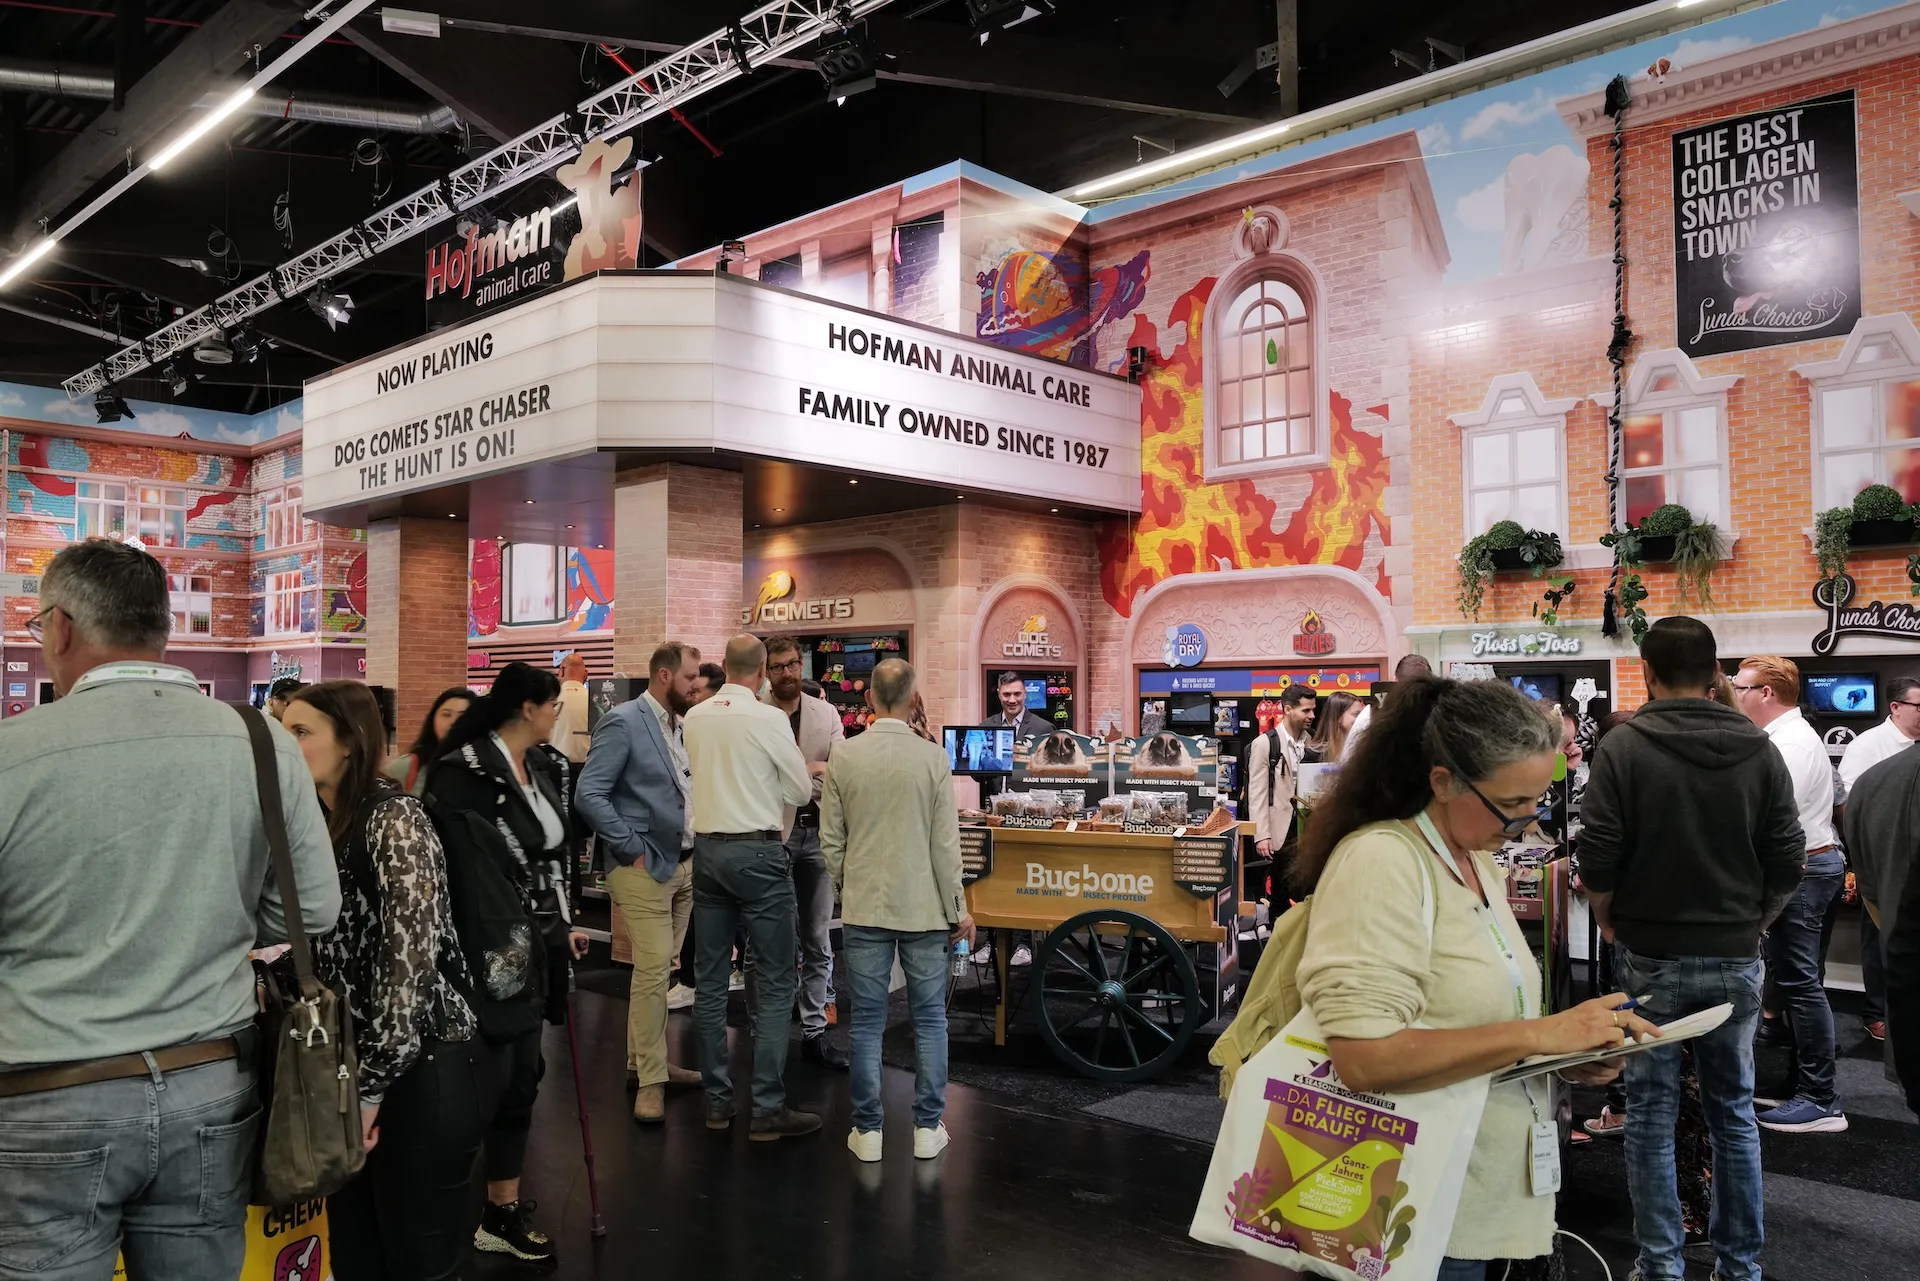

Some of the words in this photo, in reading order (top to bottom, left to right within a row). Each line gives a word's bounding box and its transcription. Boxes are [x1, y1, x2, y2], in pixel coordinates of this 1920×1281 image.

[1680, 128, 1728, 166] THE
[1736, 109, 1803, 153] BEST
[1681, 140, 1815, 198] COLLAGEN
[1682, 181, 1784, 230] SNACKS
[1793, 172, 1820, 207] IN
[426, 206, 552, 300] Hofman
[1682, 219, 1757, 262] TOWN
[476, 272, 519, 306] animal
[521, 262, 551, 288] care
[1753, 303, 1813, 327] Choice
[378, 359, 417, 394] NOW
[422, 333, 494, 380] PLAYING
[829, 322, 941, 374] HOFMAN
[950, 353, 1036, 396] ANIMAL
[1042, 376, 1090, 408] CARE
[335, 438, 365, 467] DOG
[370, 419, 428, 458] COMETS
[434, 407, 474, 440] STAR
[479, 384, 551, 427] CHASER
[799, 387, 890, 428] FAMILY
[898, 407, 989, 446] OWNED
[997, 427, 1054, 459] SINCE
[1063, 440, 1109, 469] 1987
[360, 464, 387, 490] THE
[395, 449, 443, 482] HUNT
[451, 442, 468, 468] IS
[476, 429, 516, 462] ON!
[761, 598, 852, 622] COMETS
[1003, 643, 1061, 658] COMETS
[1018, 631, 1048, 645] DOG
[1178, 633, 1201, 645] ROYAL
[1179, 644, 1202, 657] DRY
[1472, 631, 1517, 655] Floss
[1537, 631, 1580, 653] Toss
[1005, 815, 1053, 828] Bugbone
[1016, 888, 1041, 896] MADE
[1043, 888, 1062, 897] WITH
[1083, 891, 1111, 900] INSECT
[1112, 893, 1147, 902] PROTEIN
[1025, 863, 1153, 897] Bugbone
[1296, 1074, 1304, 1084] 4
[1292, 1110, 1361, 1142] DRAUF!
[1316, 1097, 1367, 1125] FLIEG
[1371, 1113, 1407, 1137] ICH
[1333, 1163, 1364, 1181] Jahres
[1342, 1155, 1369, 1170] Ganz-
